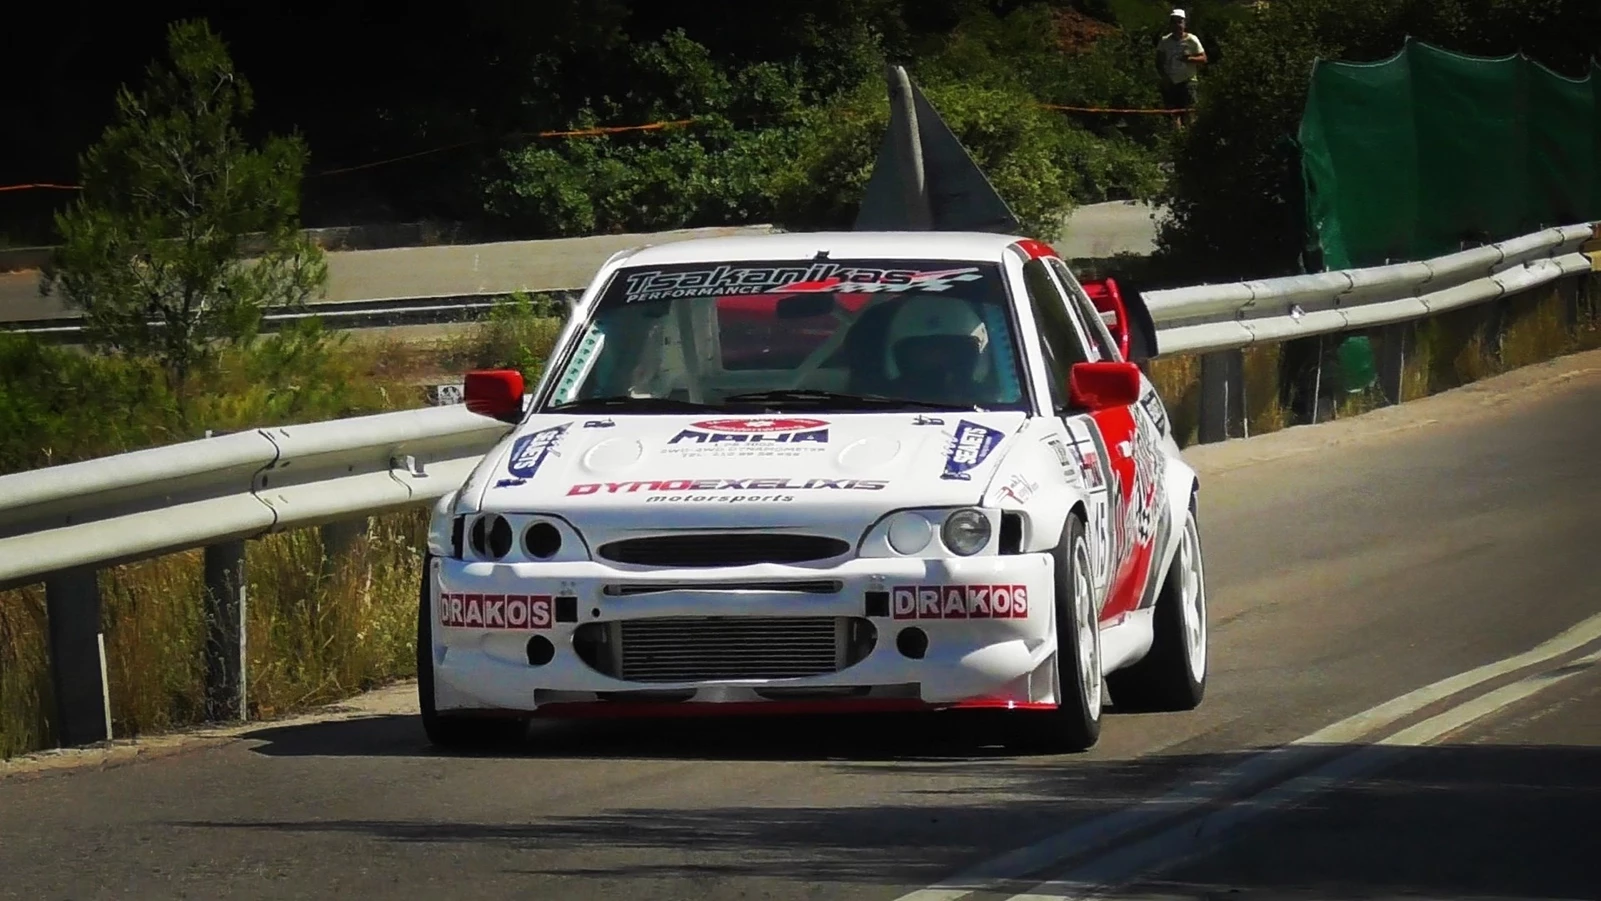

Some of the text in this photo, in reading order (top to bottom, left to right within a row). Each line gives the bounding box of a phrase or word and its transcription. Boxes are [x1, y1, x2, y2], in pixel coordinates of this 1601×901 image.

[626, 263, 914, 294] Tsakanikas
[626, 284, 763, 303] PERFORMANCE
[667, 428, 829, 444] MAHA
[565, 478, 890, 496] DYNOEXELIXIS
[645, 493, 795, 503] motorsports
[440, 597, 551, 626] DRAKOS
[895, 588, 1027, 616] DRAKOS
